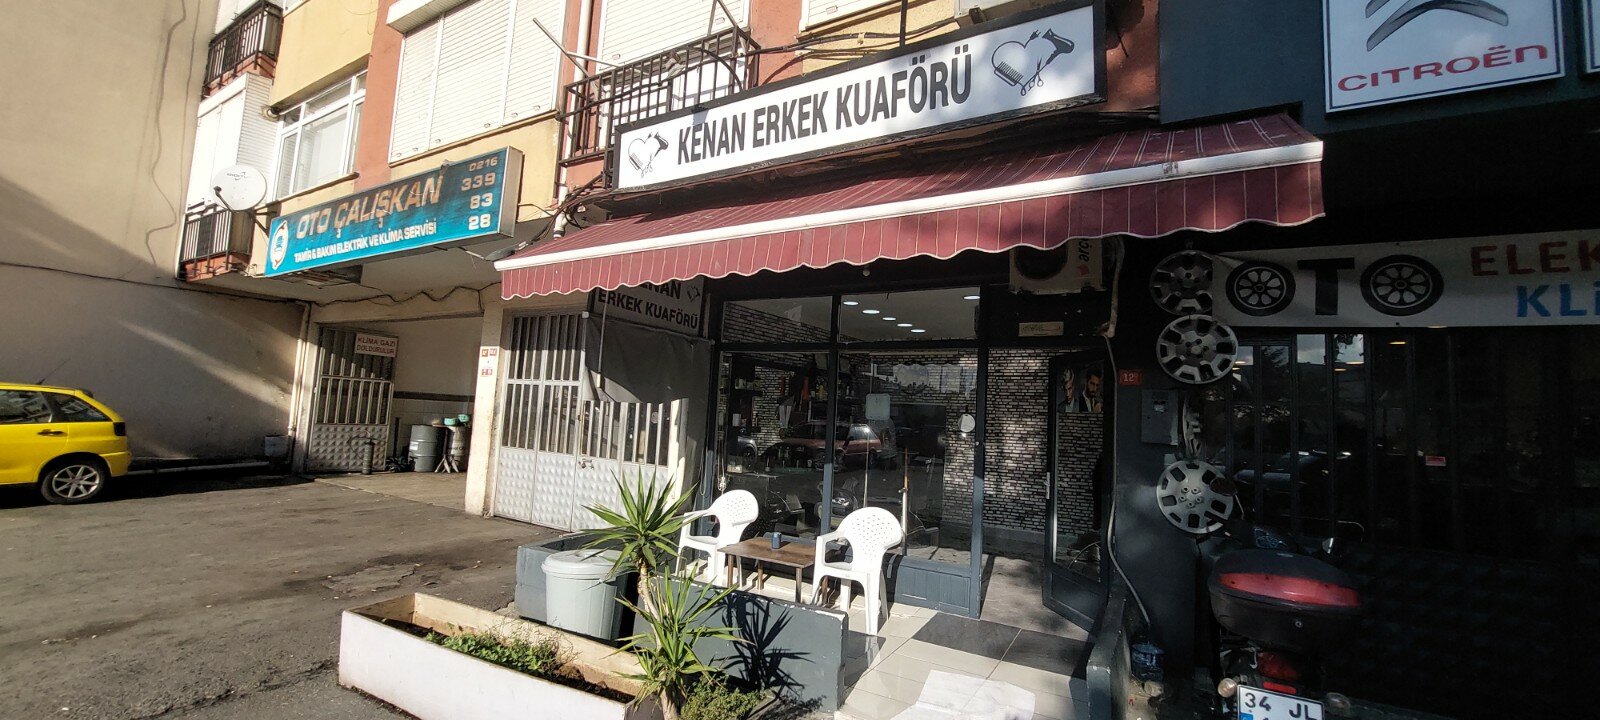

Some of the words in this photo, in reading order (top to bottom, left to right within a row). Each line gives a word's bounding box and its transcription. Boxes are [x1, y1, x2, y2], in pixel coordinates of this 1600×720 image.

[677, 112, 747, 165] KENAN
[752, 90, 829, 149] ERKEK
[835, 44, 972, 130] KUAFÖRÜ
[468, 156, 498, 172] 0216
[461, 172, 495, 191] 339
[296, 207, 332, 239] OTO
[334, 175, 443, 238] ÇALIŞKAN
[470, 192, 493, 209] 83
[468, 213, 491, 230] 28
[337, 234, 368, 254] ELEKTRİK
[369, 235, 380, 247] VE
[379, 227, 403, 245] KLİMA
[404, 218, 437, 239] SERVİSİ
[598, 290, 642, 314] ERKEK
[645, 302, 699, 329] KUAFÖRÜ
[1245, 692, 1271, 711] 34
[1289, 703, 1318, 720] JL
